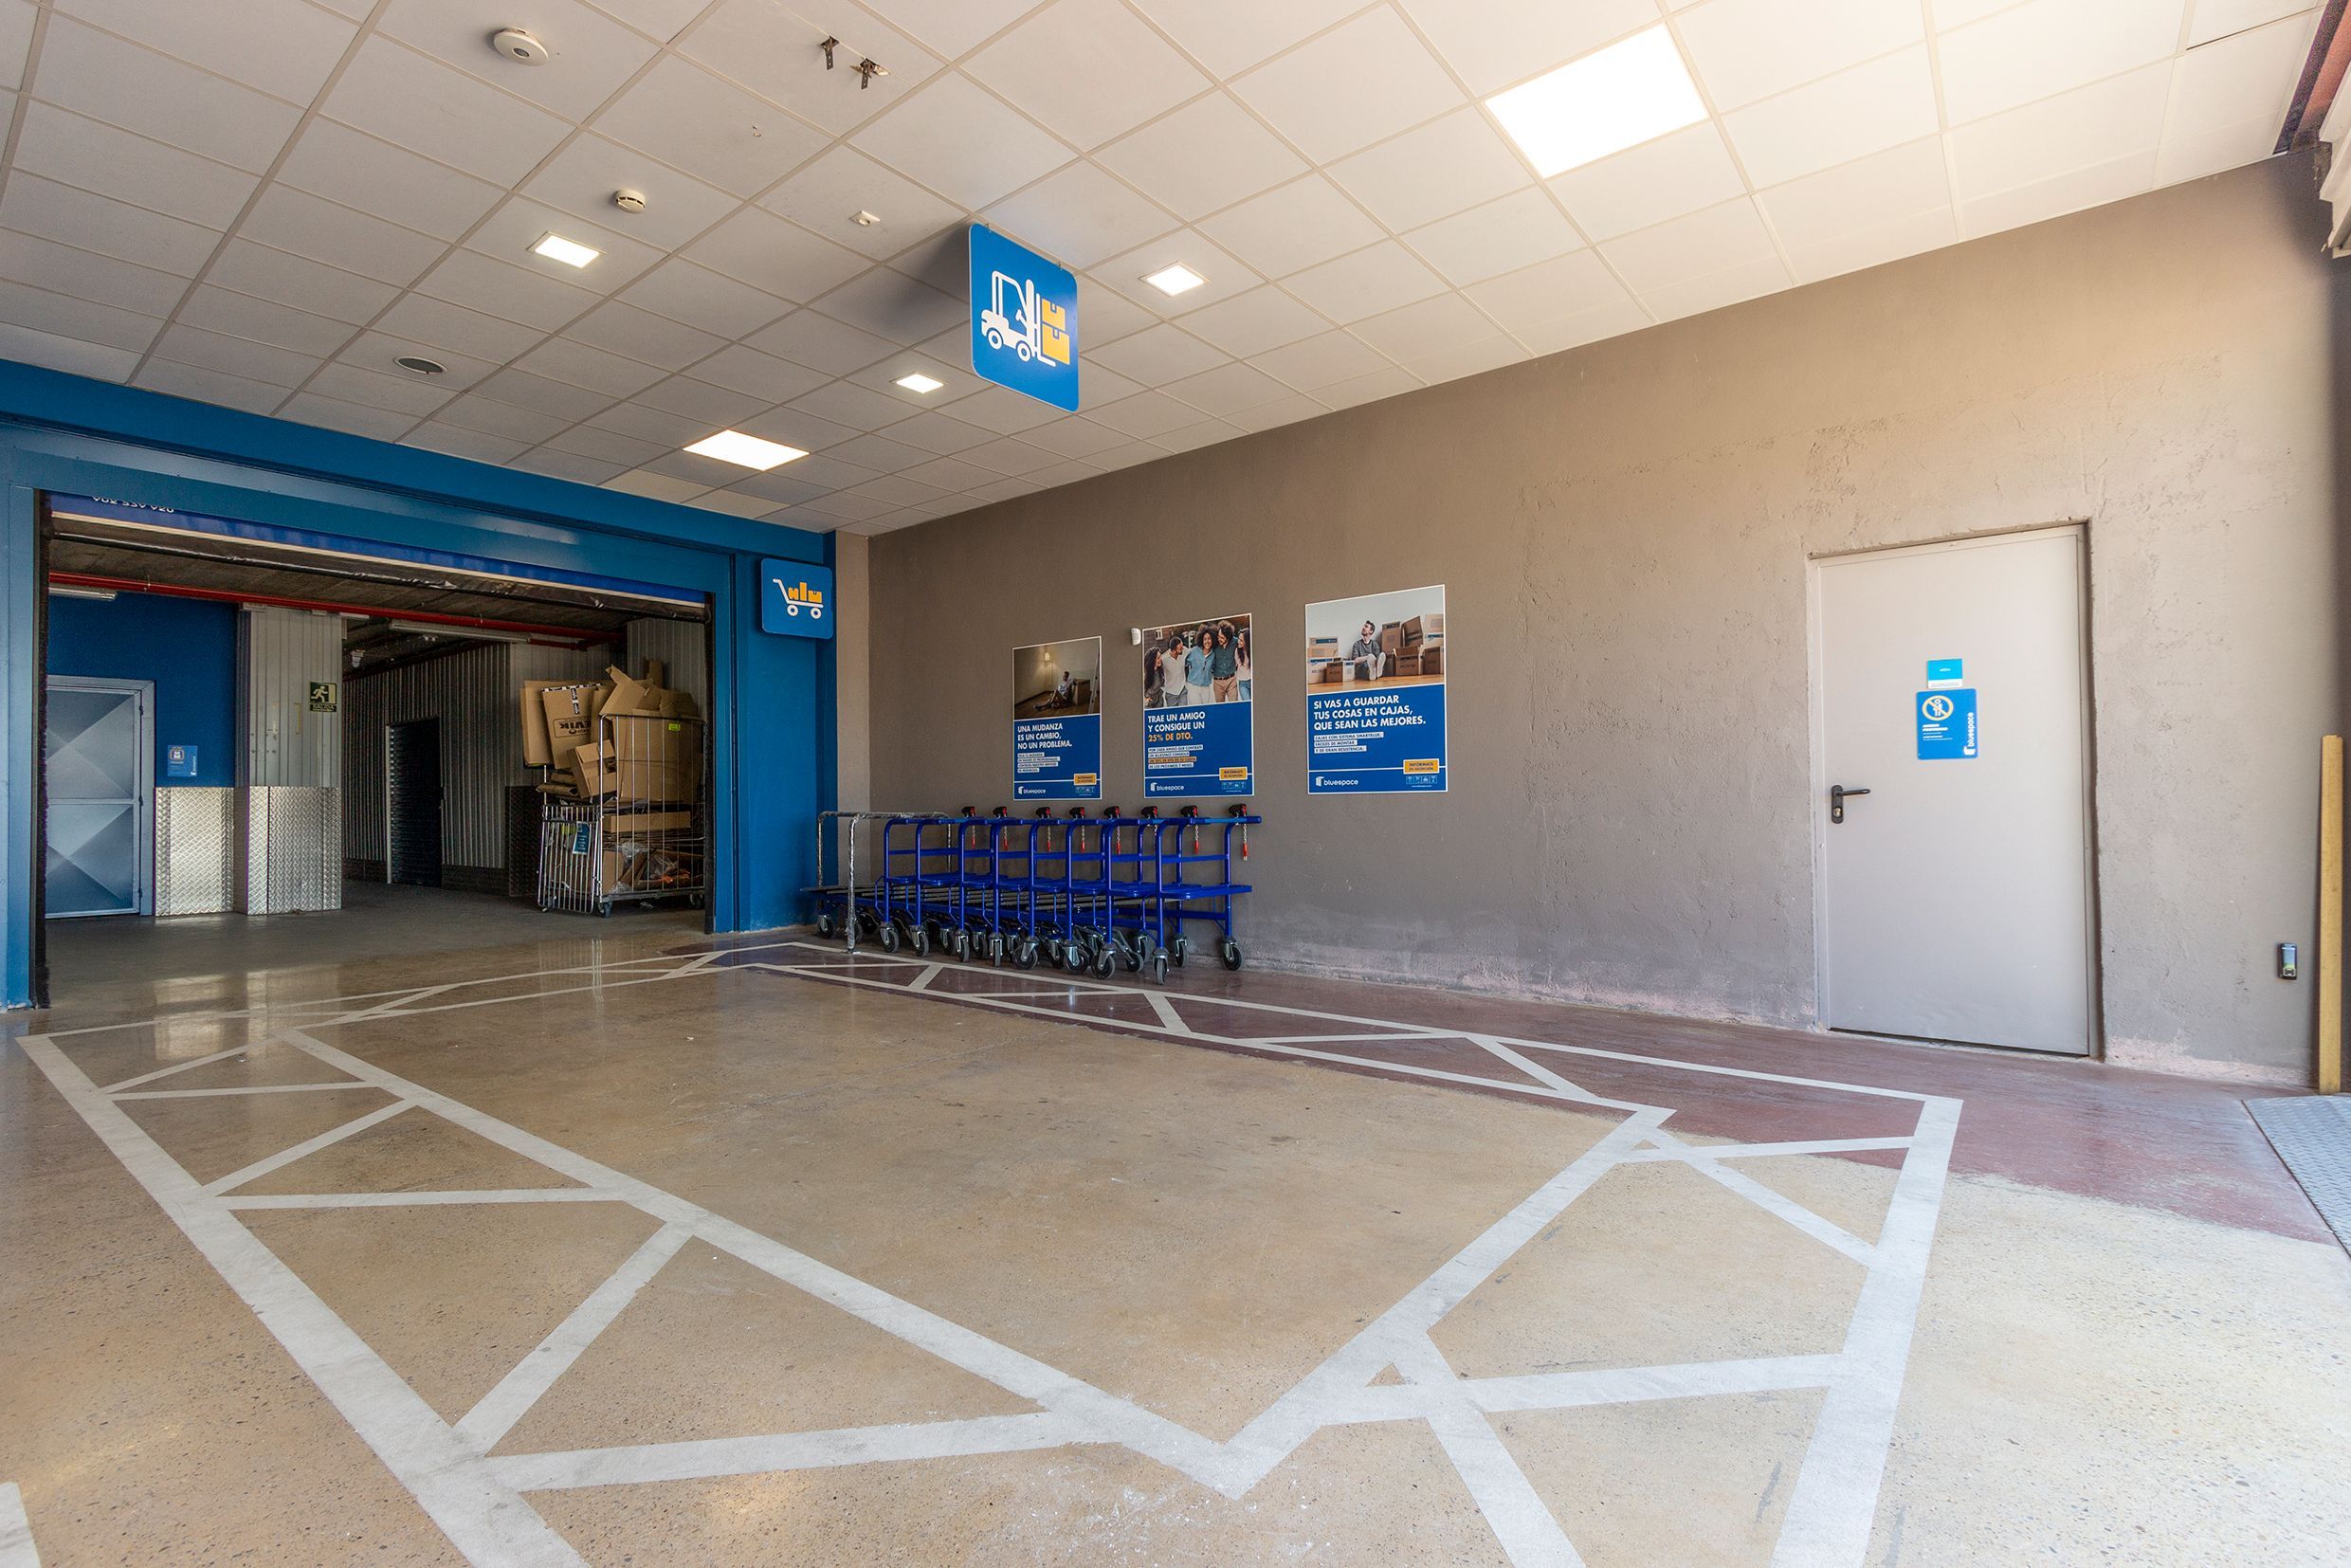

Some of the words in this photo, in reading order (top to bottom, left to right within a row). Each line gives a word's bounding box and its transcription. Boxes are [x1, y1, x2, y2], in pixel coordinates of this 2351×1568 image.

[1314, 701, 1321, 709] SI
[1324, 700, 1341, 708] VAS
[1343, 699, 1351, 707] A
[1353, 695, 1399, 706] GUARDAR
[1148, 715, 1164, 723] TRAE
[1179, 711, 1206, 720] AMIGO
[1314, 711, 1330, 720] TUS
[1332, 708, 1362, 719] COSAS
[1365, 707, 1377, 717] EN
[1380, 705, 1413, 716] CAJAS,
[1031, 722, 1063, 731] MUDANZA
[1155, 722, 1191, 732] CONSIGUE
[1314, 720, 1332, 731] QUE
[1335, 720, 1358, 729] SEAN
[1361, 719, 1377, 727] LAS
[1380, 716, 1426, 727] MEJORES.
[1165, 733, 1174, 741] DE
[1176, 732, 1193, 740] DTO.
[1039, 739, 1072, 749] PROBLEMA.
[1324, 778, 1358, 787] bluespace
